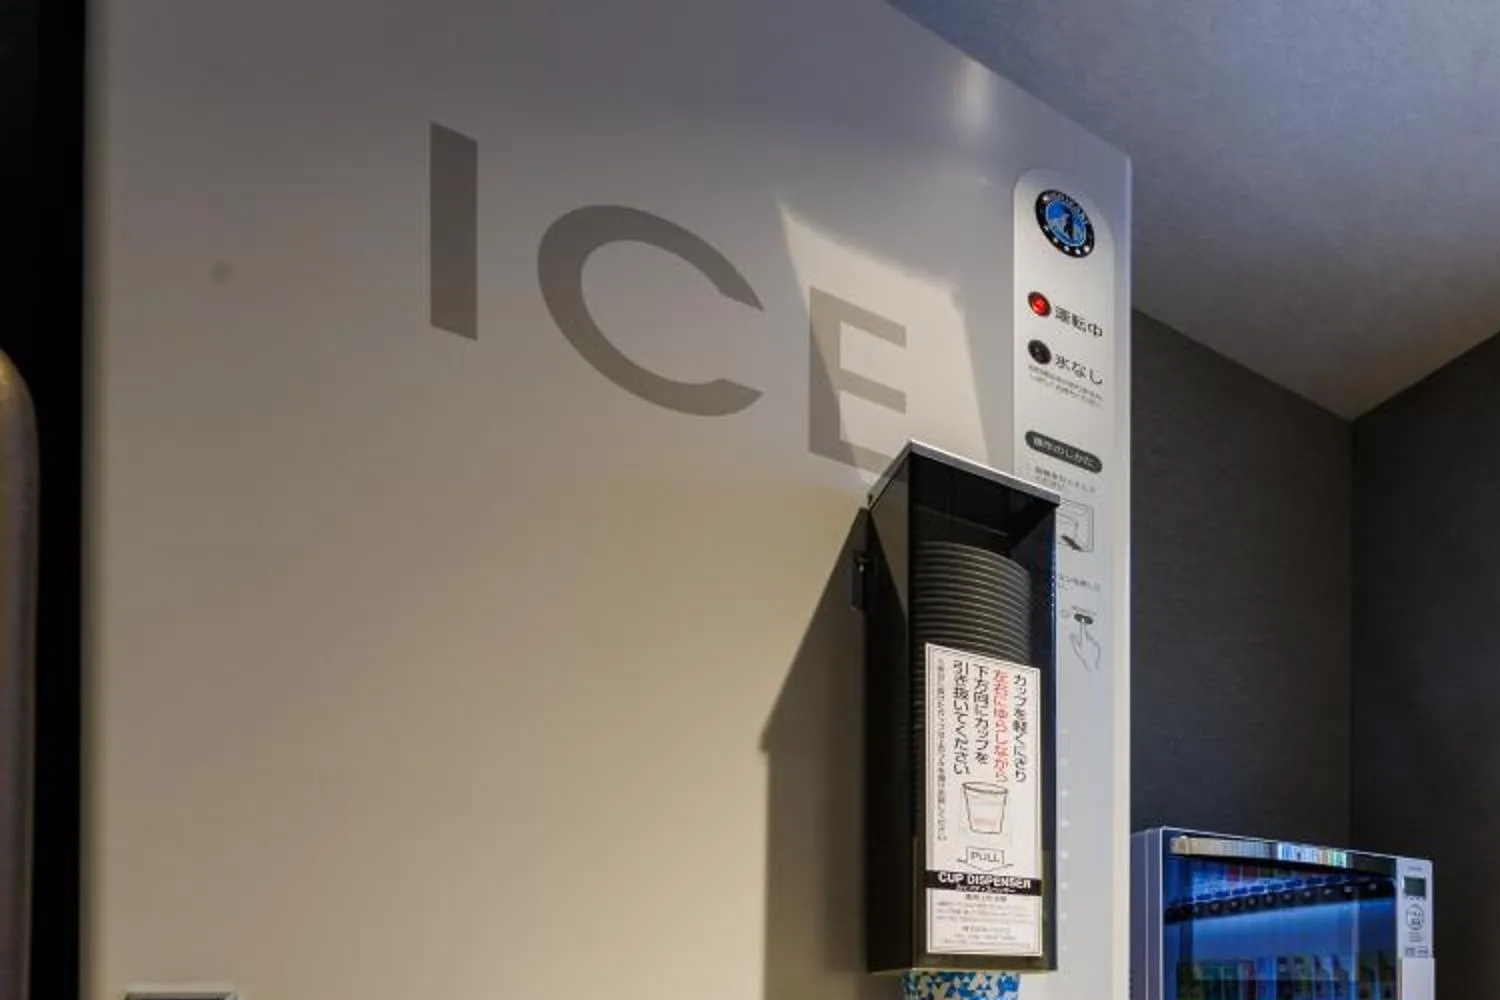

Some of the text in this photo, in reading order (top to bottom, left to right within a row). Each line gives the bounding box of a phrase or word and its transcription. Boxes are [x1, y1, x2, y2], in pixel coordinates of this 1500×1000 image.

[430, 120, 907, 480] ICE
[1054, 305, 1104, 338] 運転中
[1055, 353, 1104, 386] 氷なし
[953, 659, 970, 776] 引き抜いてください
[971, 851, 1001, 863] PULL
[937, 871, 965, 884] CUP
[967, 873, 1032, 889] DISPENSER
